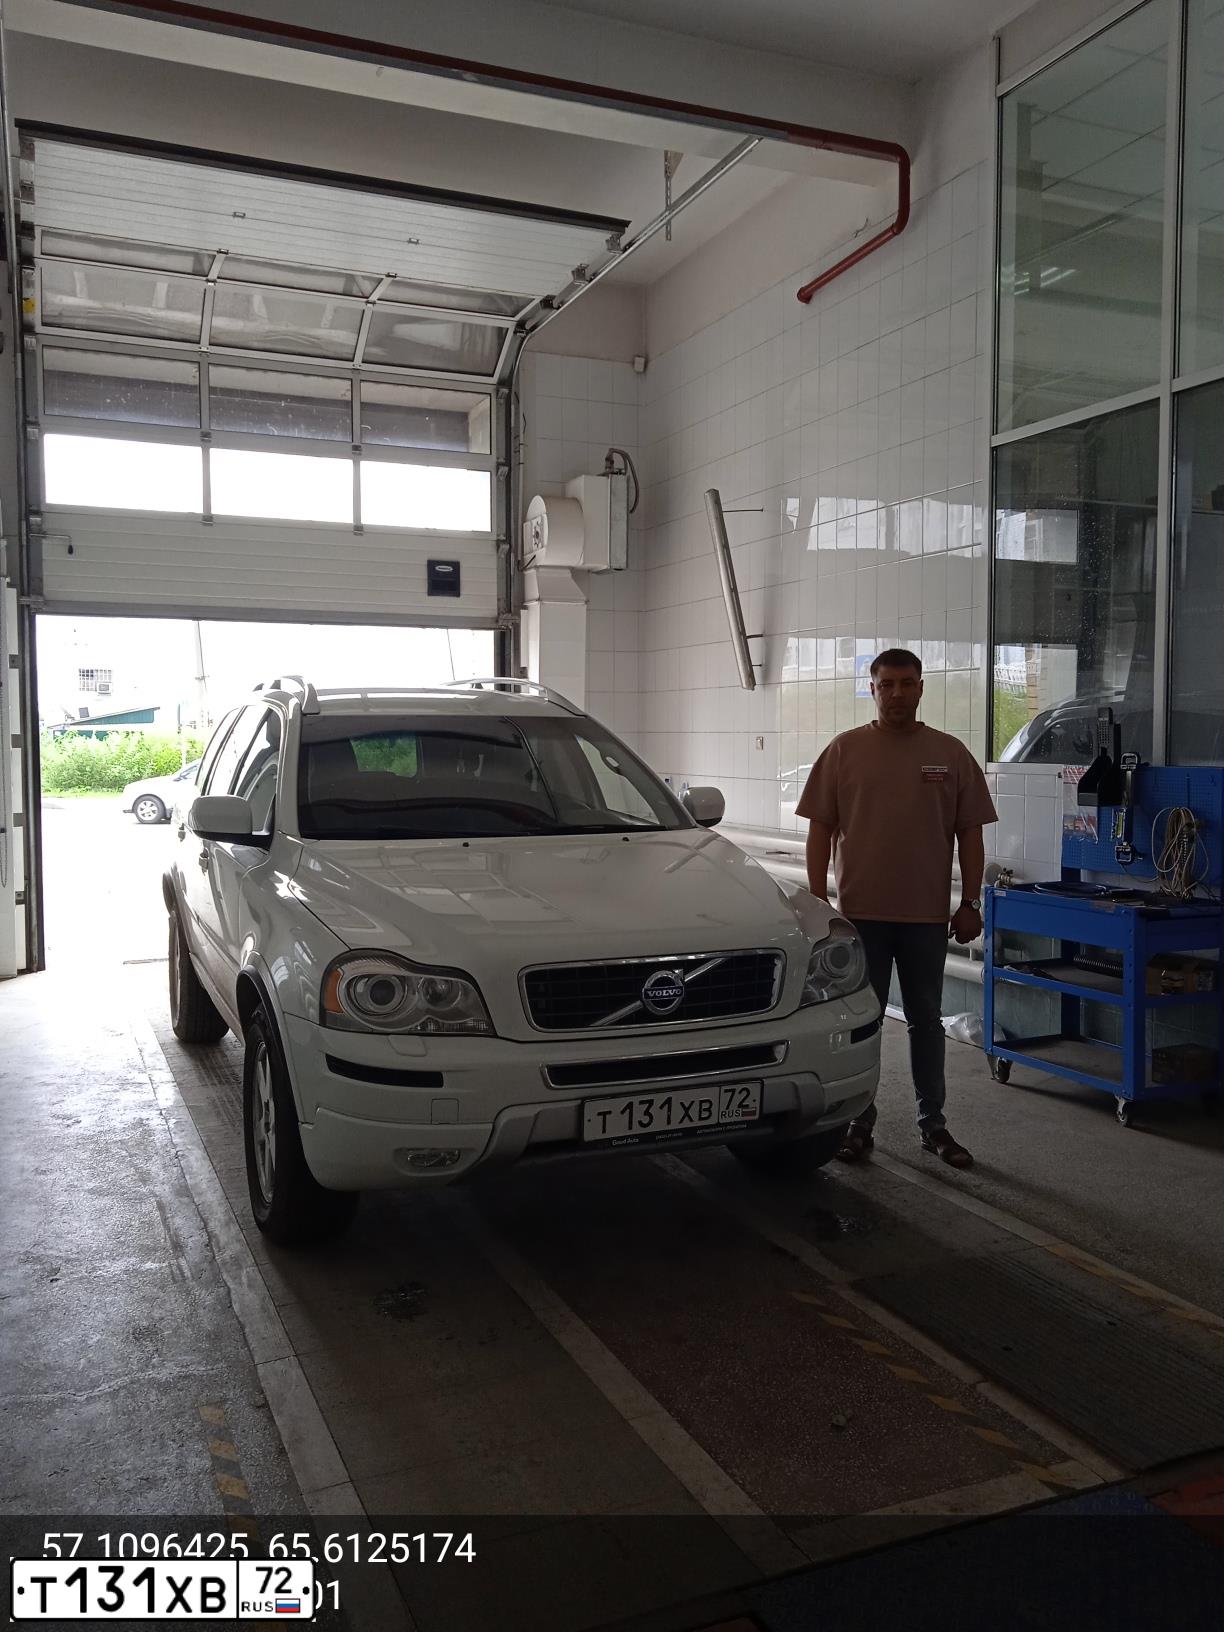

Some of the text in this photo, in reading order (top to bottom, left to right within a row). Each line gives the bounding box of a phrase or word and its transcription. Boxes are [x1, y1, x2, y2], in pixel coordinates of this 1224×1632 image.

[646, 988, 682, 997] VOLVO
[723, 1087, 751, 1111] 72
[720, 1109, 742, 1119] RUS
